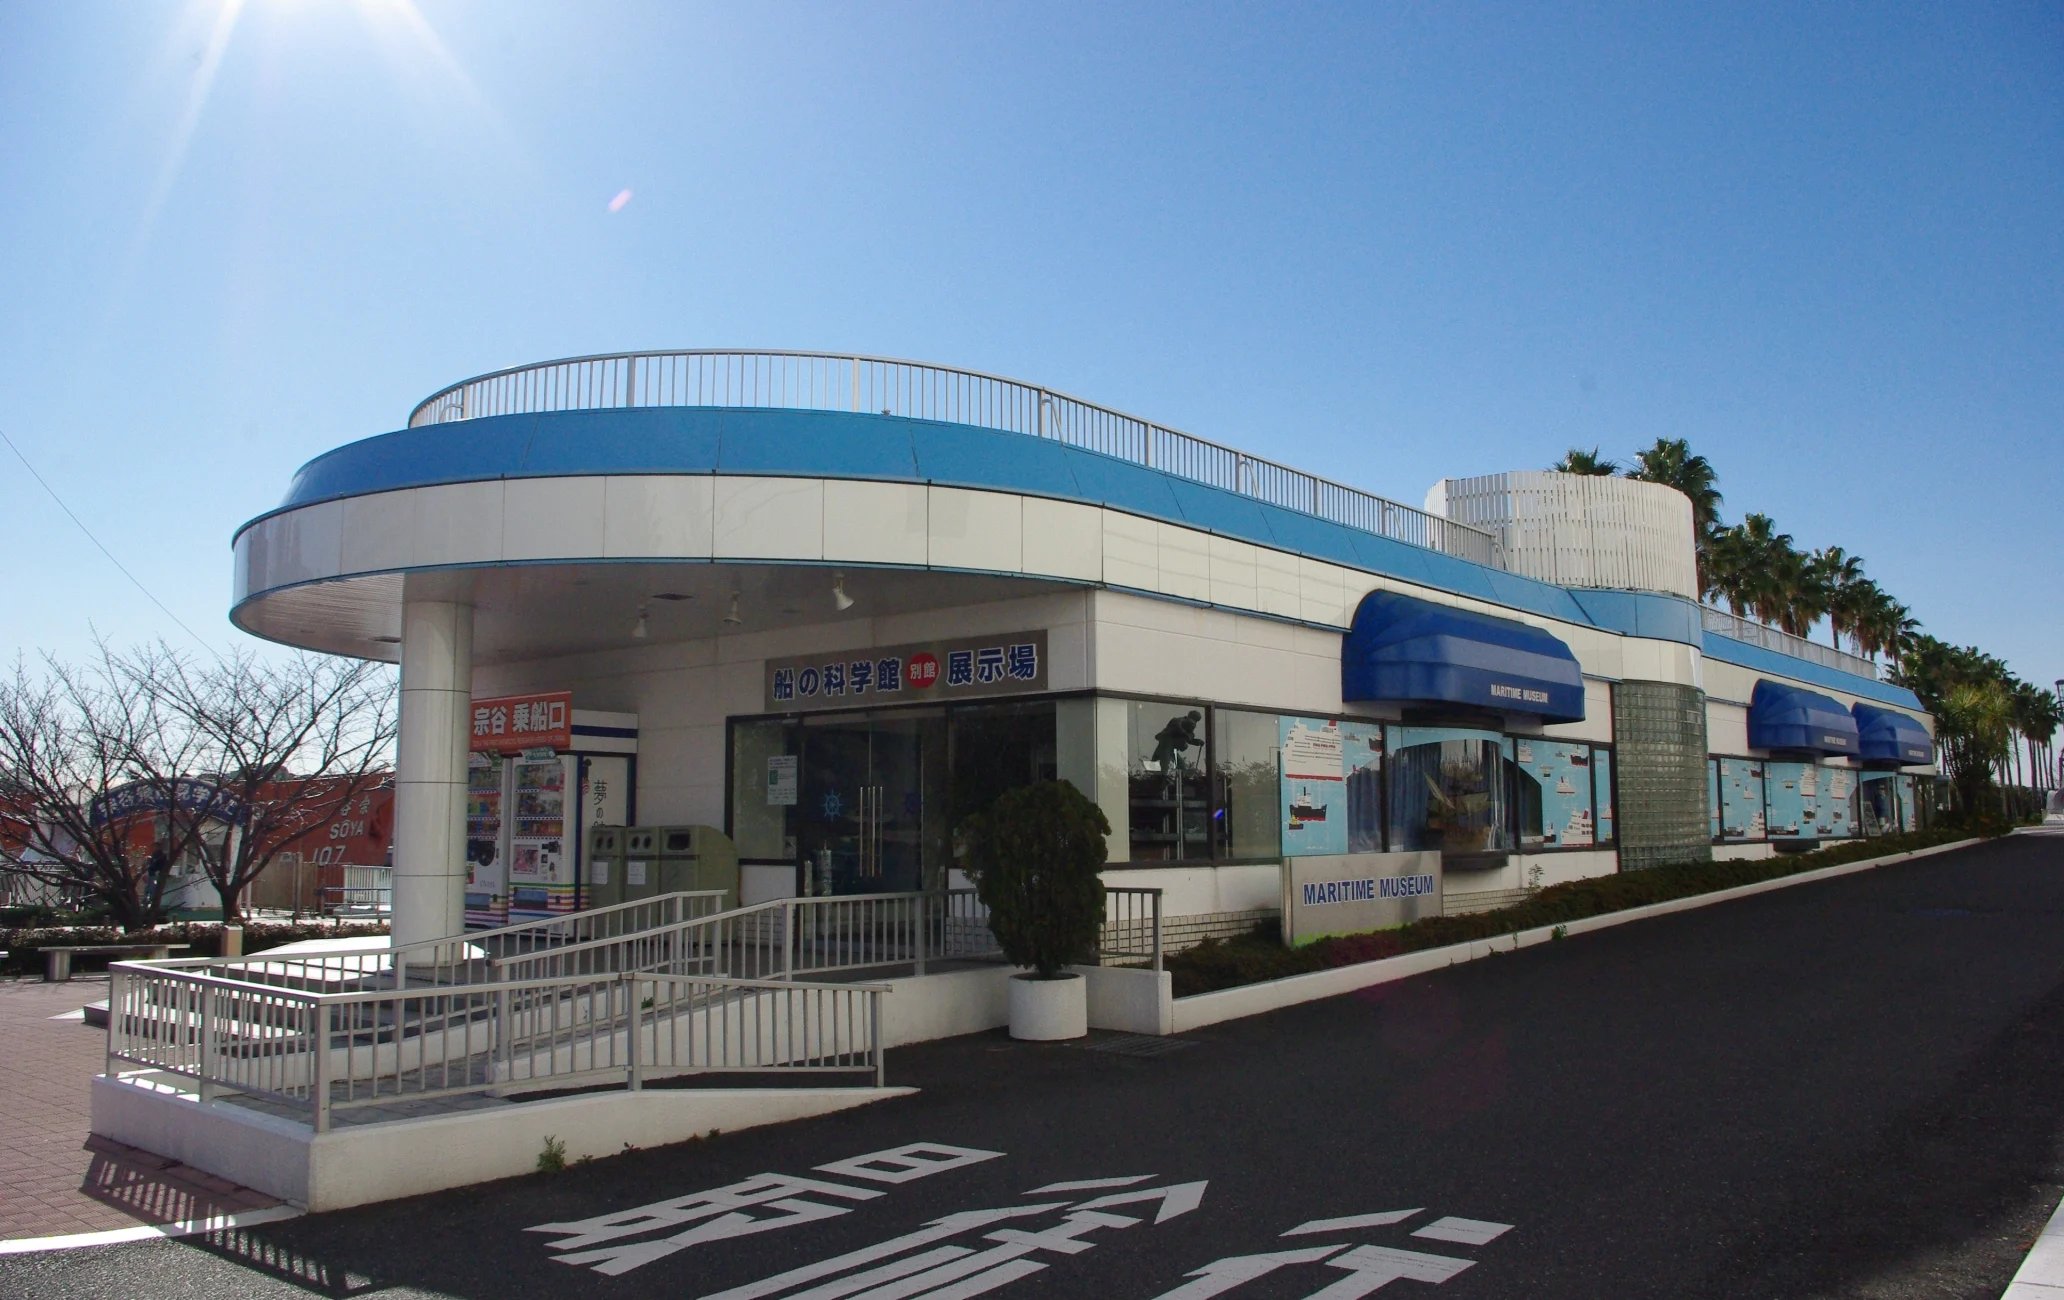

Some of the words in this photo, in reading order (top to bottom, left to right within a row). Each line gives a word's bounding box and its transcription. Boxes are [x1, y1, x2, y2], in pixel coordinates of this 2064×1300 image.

[774, 657, 902, 700] 船の科学館
[910, 663, 936, 680] 別館
[947, 643, 1038, 686] 展示場
[1490, 684, 1522, 699] MARITIME
[1522, 689, 1549, 703] MUSEUM
[474, 706, 508, 736] 宗谷
[512, 701, 566, 733] 乗船口
[312, 844, 347, 867] 107
[1303, 879, 1375, 906] MARITIME
[1379, 874, 1434, 900] MUSEUM
